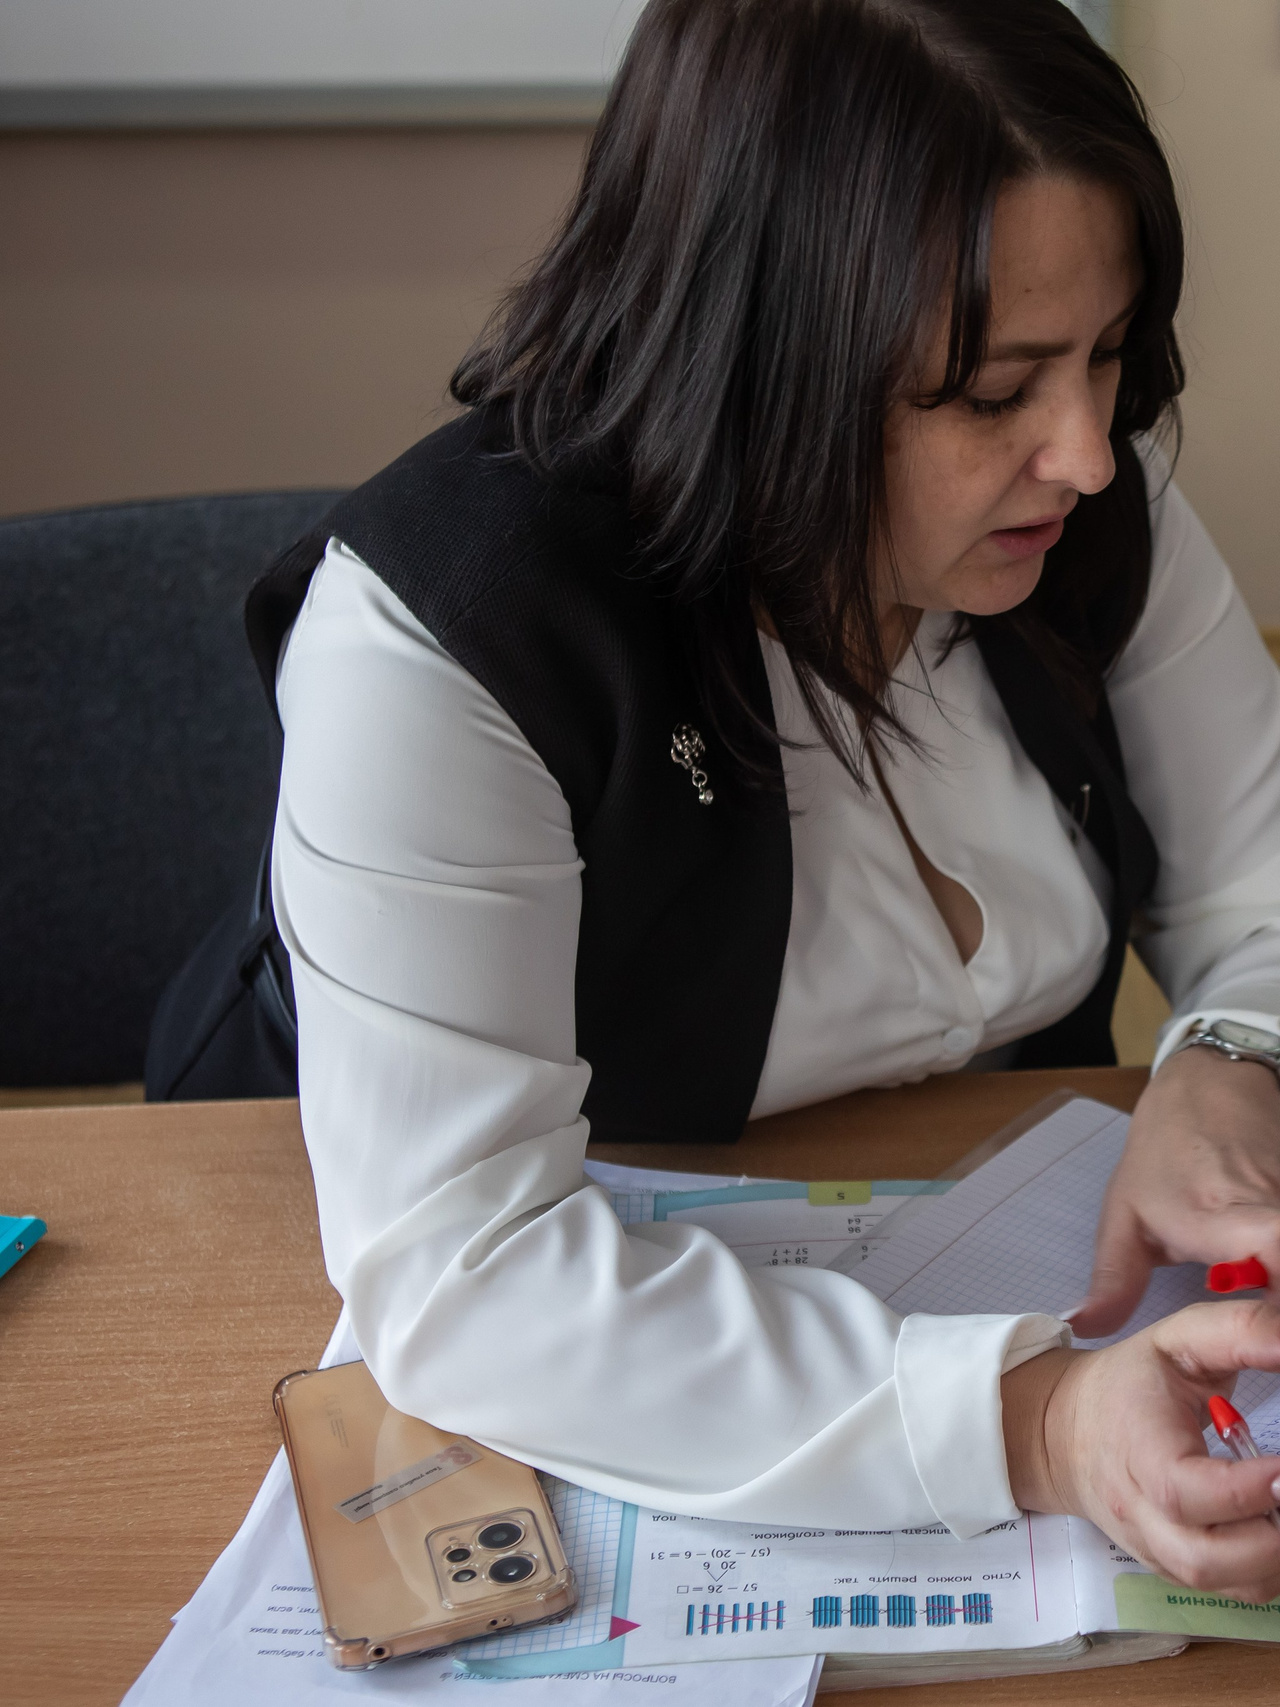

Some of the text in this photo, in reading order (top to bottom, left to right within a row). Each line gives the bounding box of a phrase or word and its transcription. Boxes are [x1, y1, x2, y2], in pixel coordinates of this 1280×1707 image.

[750, 1531, 825, 1541] столбиком.
[901, 1528, 951, 1536] аписать
[650, 1551, 665, 1560] 31
[684, 1550, 692, 1559] 6
[711, 1548, 731, 1558] 20)
[751, 1547, 771, 1558] (57
[703, 1561, 736, 1571] 20 6
[833, 1571, 1021, 1585] Устно можно решить так:
[707, 1585, 723, 1594] 26
[743, 1583, 758, 1592] 57
[257, 1649, 305, 1658] бабушки
[593, 1672, 610, 1681] НА
[612, 1672, 677, 1684] ВОПРОСЫ
